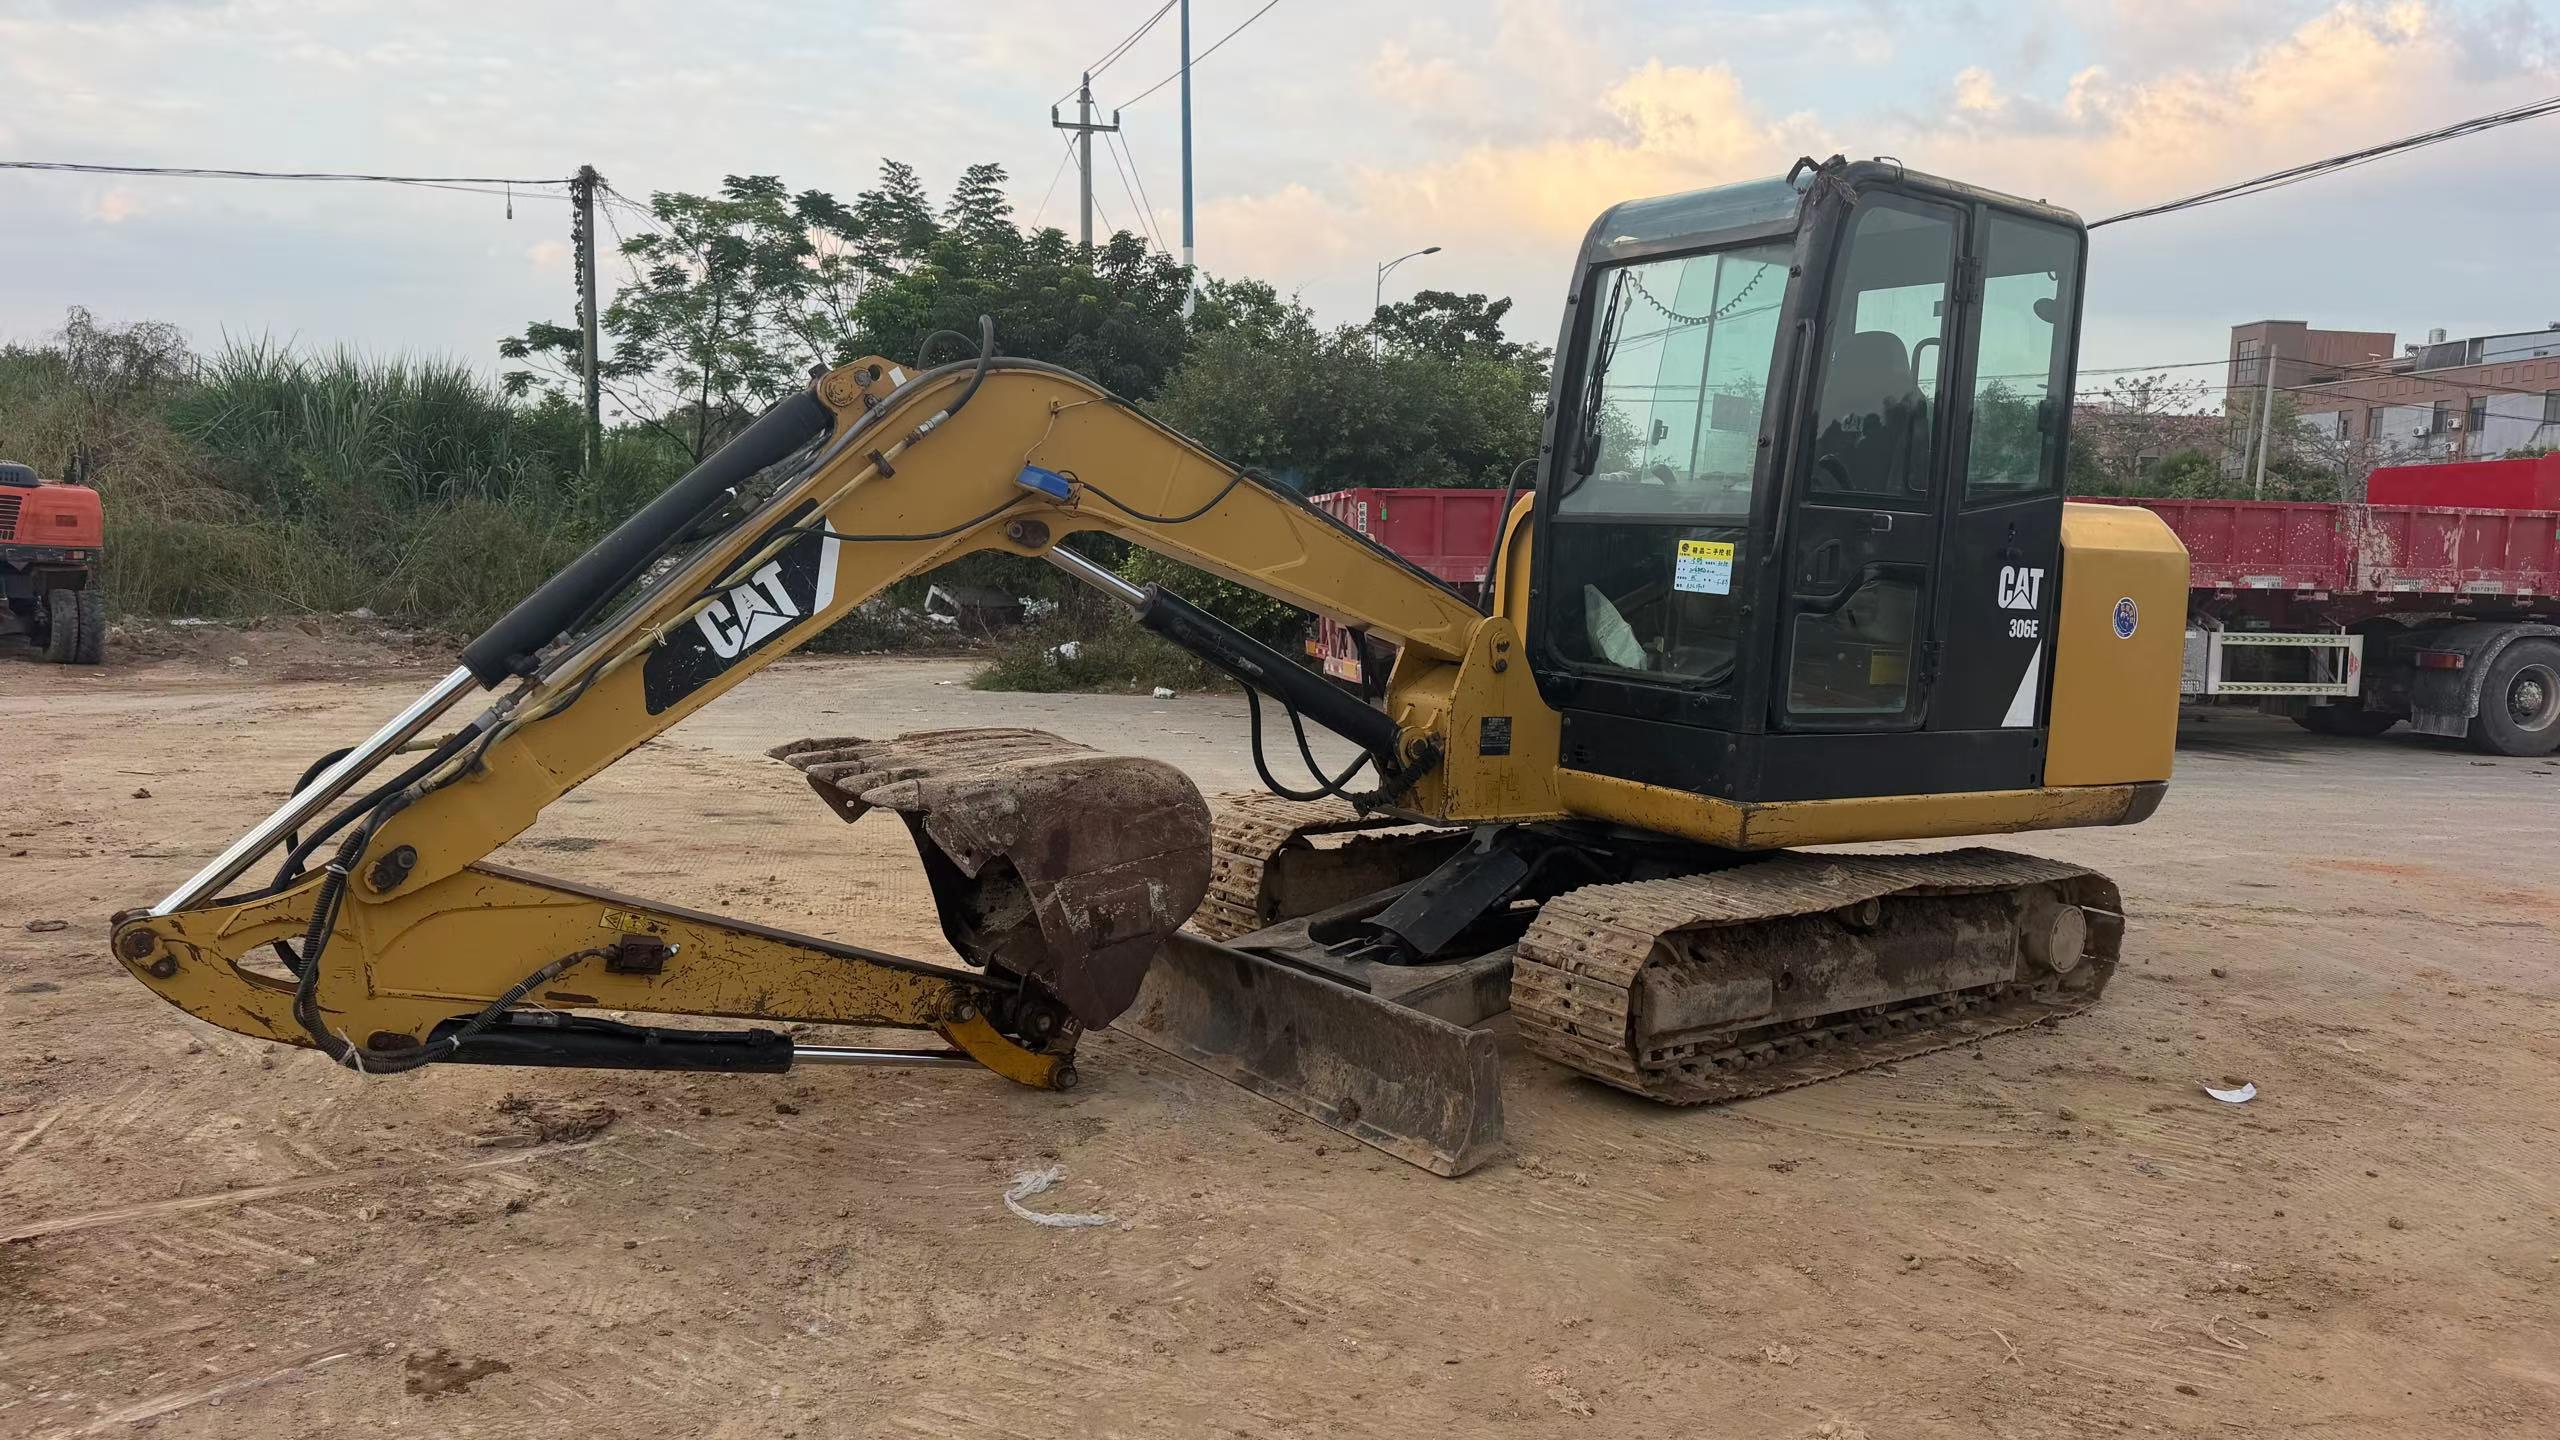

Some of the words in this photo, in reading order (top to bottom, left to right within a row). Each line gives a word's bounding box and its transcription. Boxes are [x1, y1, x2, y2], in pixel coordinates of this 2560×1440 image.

[694, 560, 800, 659] CAT
[1998, 565, 2044, 611] CAT
[2009, 618, 2039, 638] 306E
